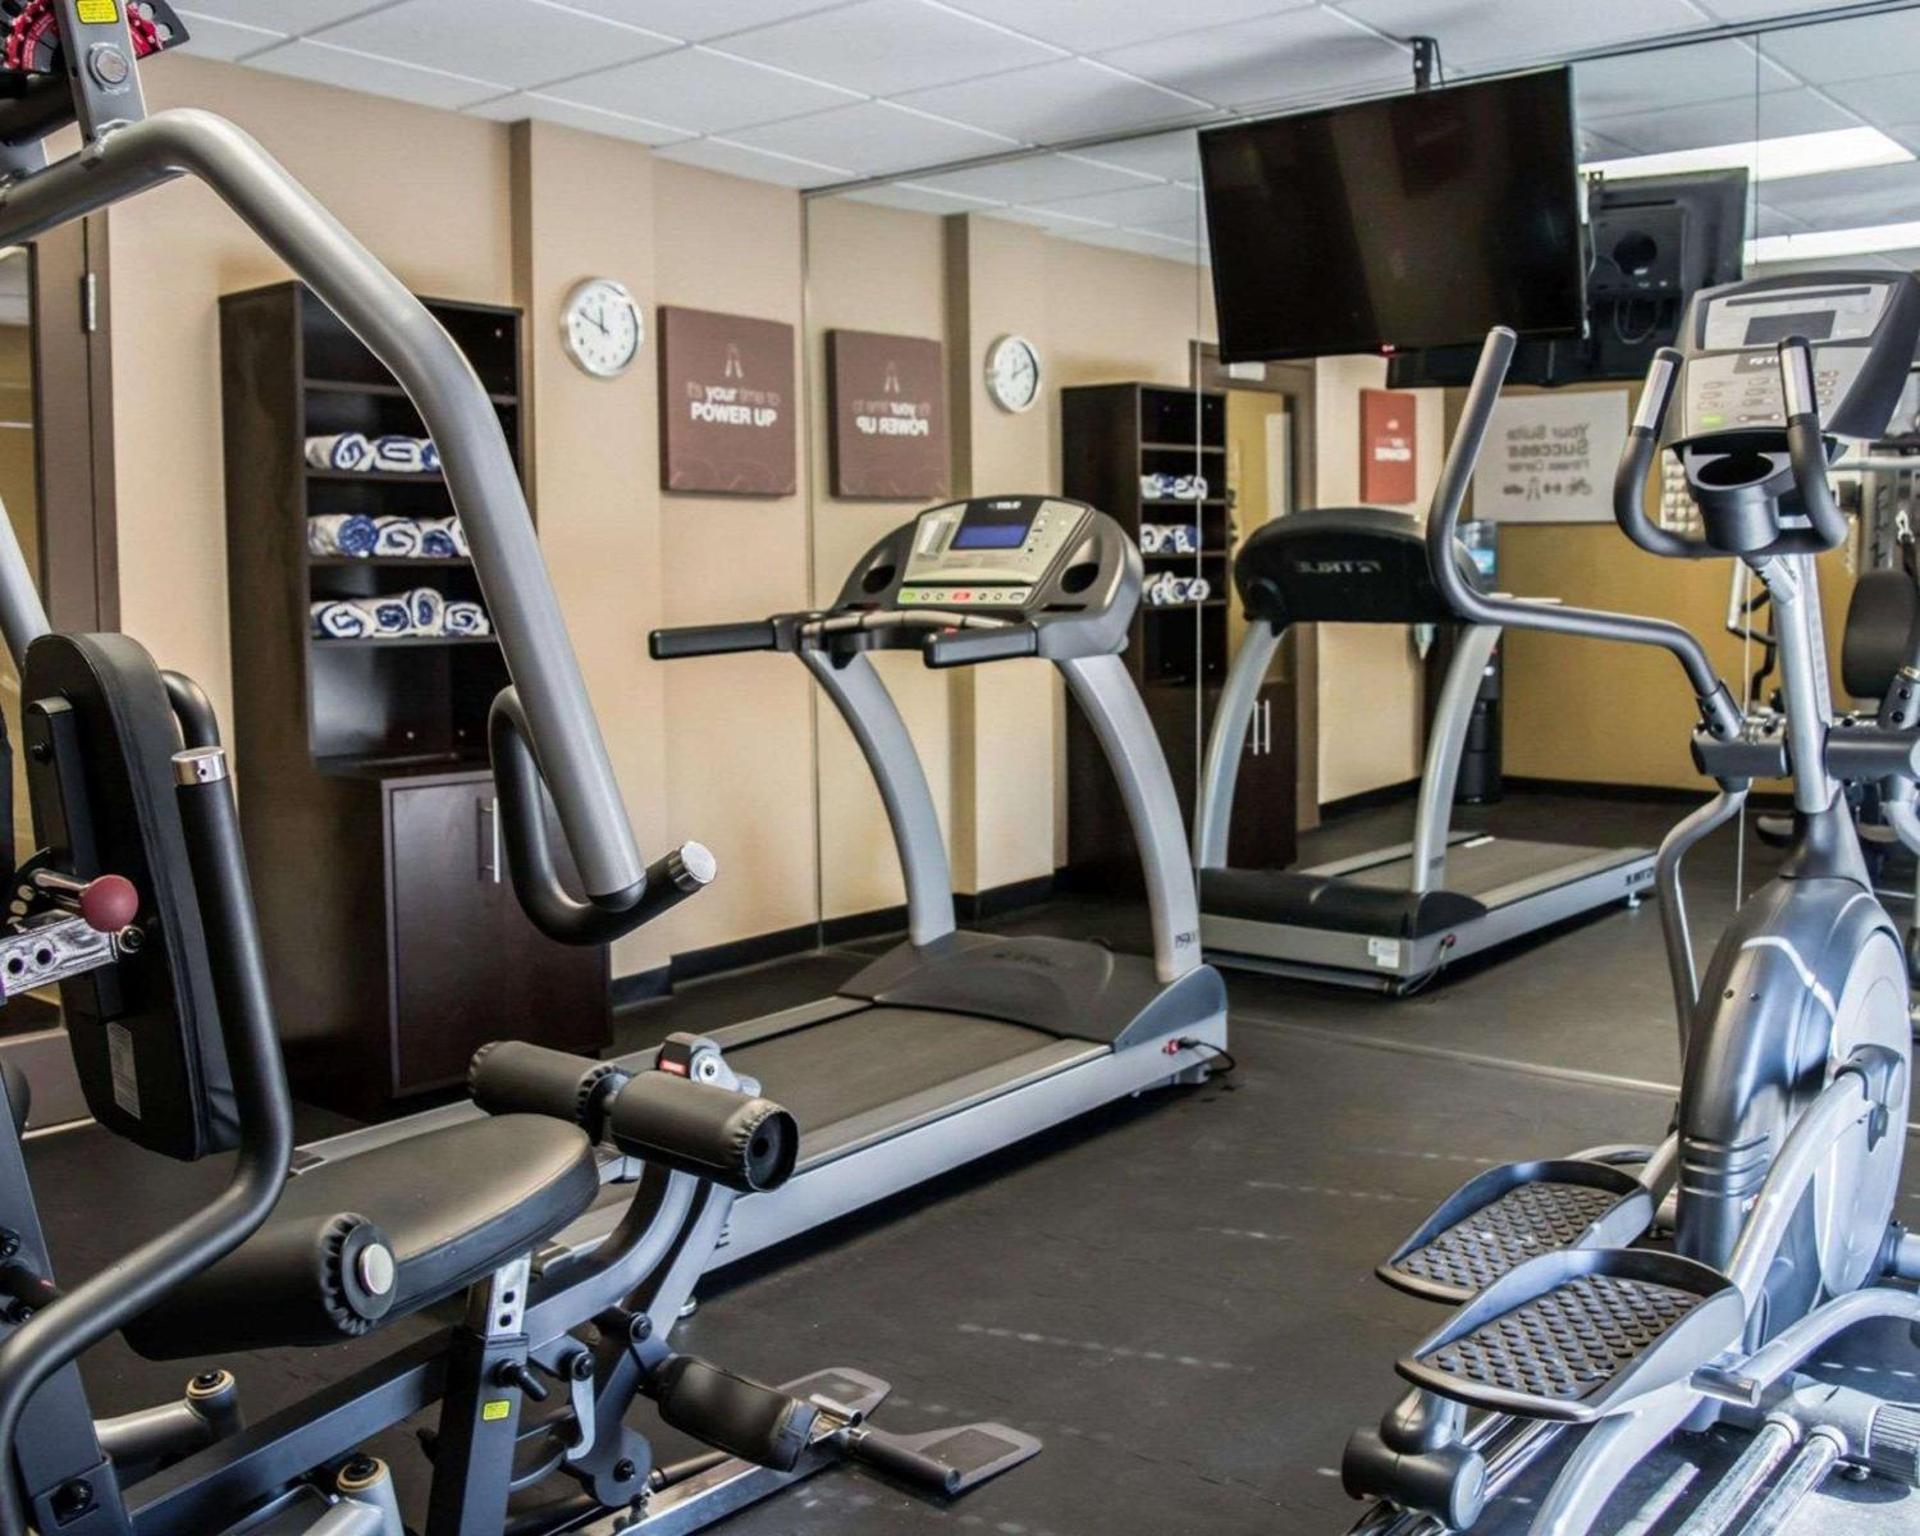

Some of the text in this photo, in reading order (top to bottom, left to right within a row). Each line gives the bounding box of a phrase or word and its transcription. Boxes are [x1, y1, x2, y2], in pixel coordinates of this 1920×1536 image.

[705, 386, 737, 404] your
[691, 401, 778, 427] POWER UP
